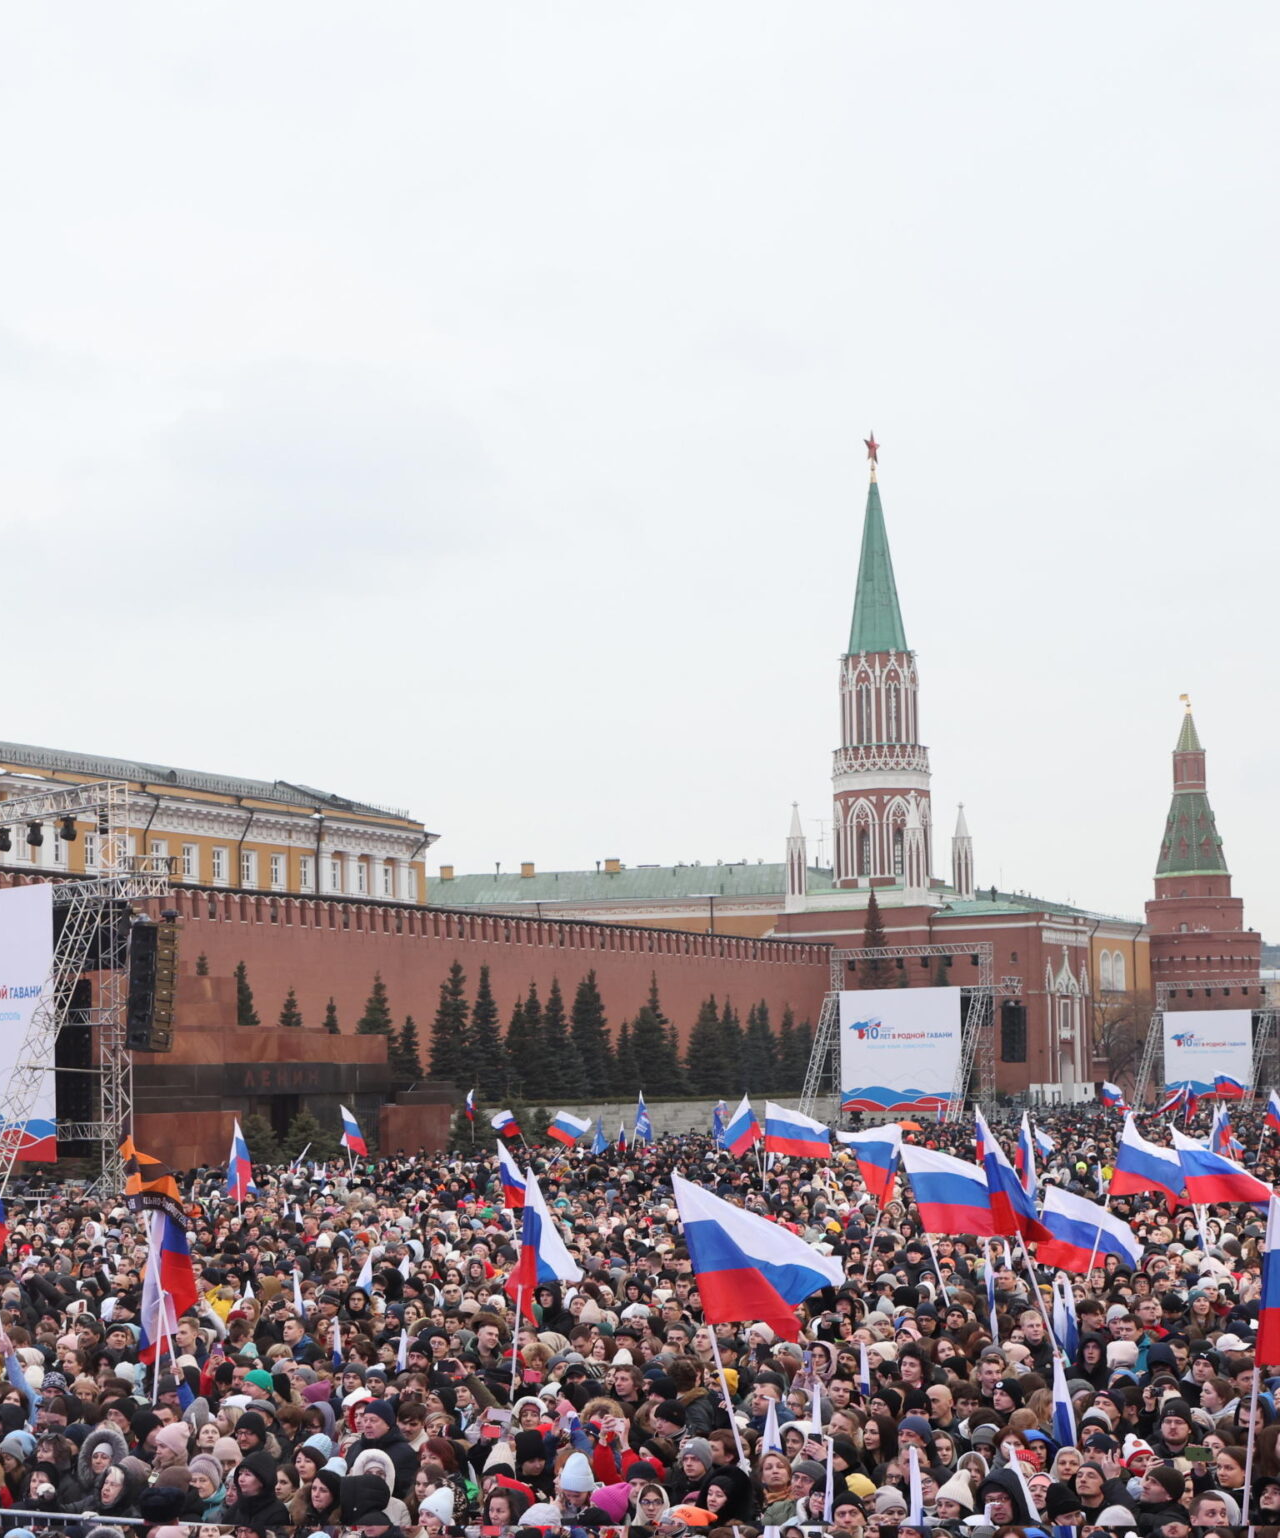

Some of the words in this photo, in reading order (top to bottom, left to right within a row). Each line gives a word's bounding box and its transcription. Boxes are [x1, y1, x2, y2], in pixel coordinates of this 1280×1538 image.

[9, 985, 42, 999] ГАВАНИ
[864, 1027, 879, 1040] 10
[897, 1030, 925, 1041] РОДНОЙ
[243, 1070, 320, 1088] ЛЕНИН
